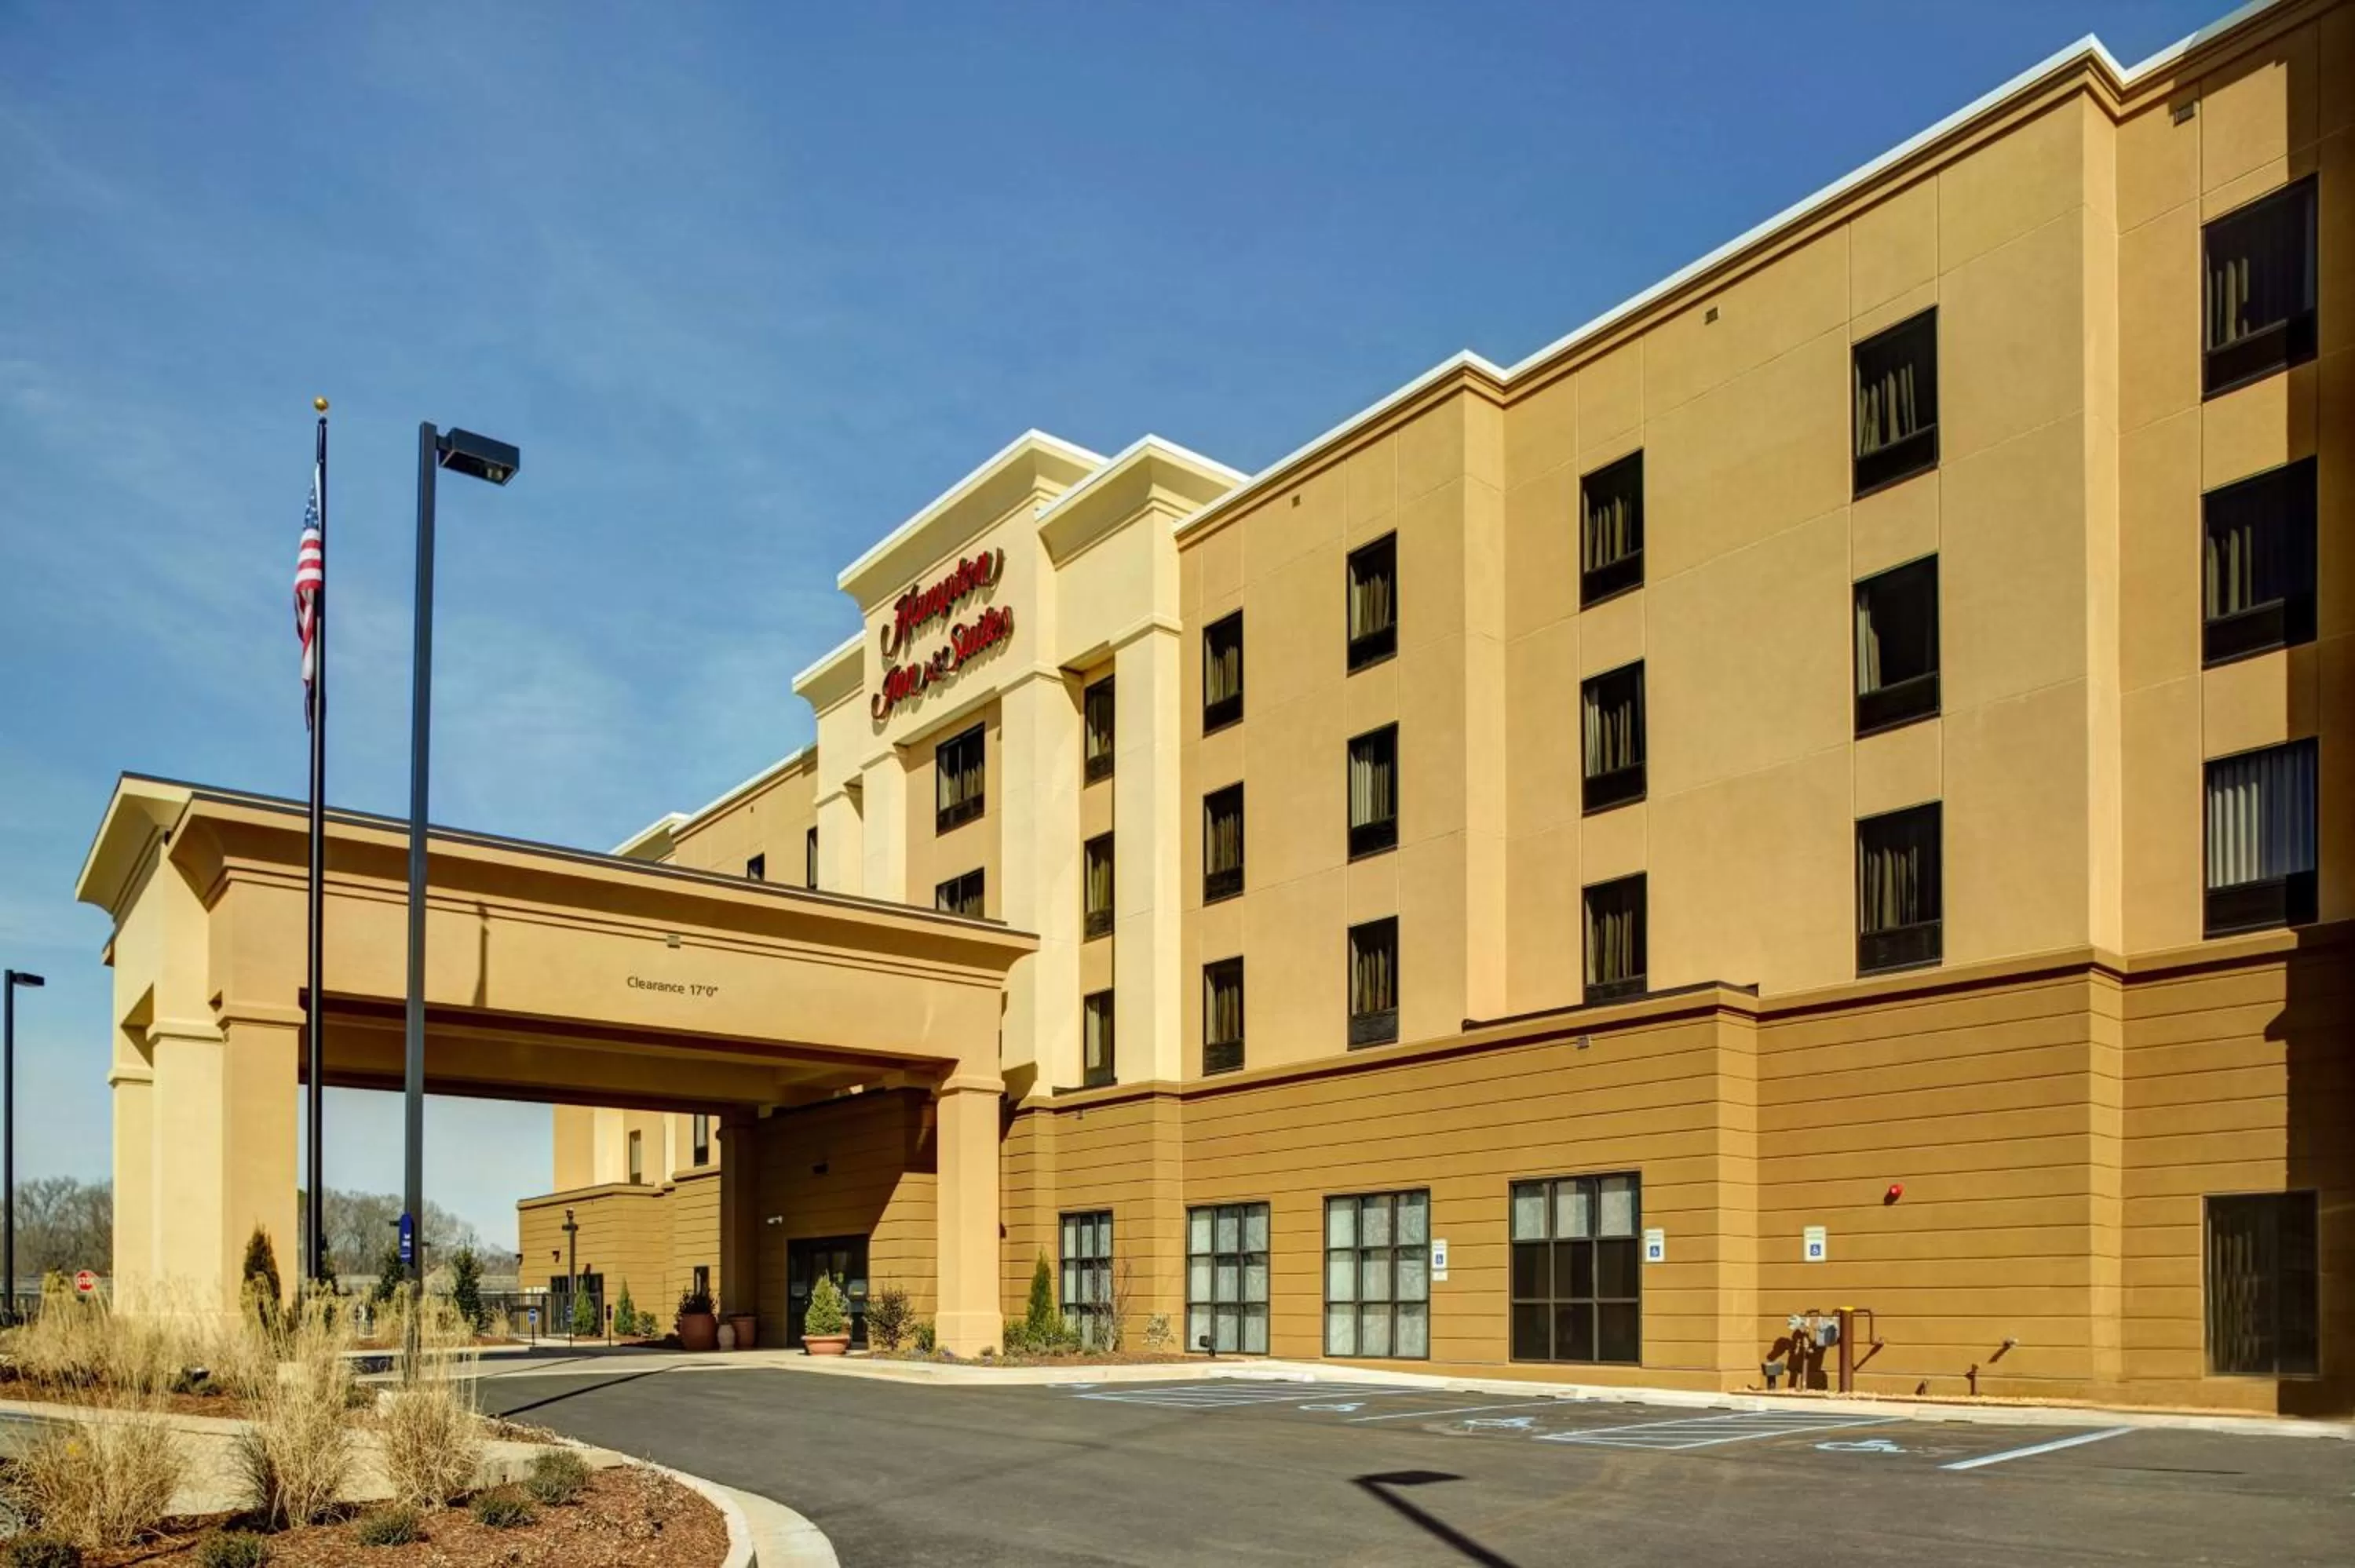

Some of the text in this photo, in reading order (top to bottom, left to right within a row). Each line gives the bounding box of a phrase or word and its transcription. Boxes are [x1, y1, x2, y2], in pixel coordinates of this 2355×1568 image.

[880, 547, 1004, 657] Hampton
[871, 605, 1014, 720] Inn & Suites
[626, 975, 685, 994] Clearance
